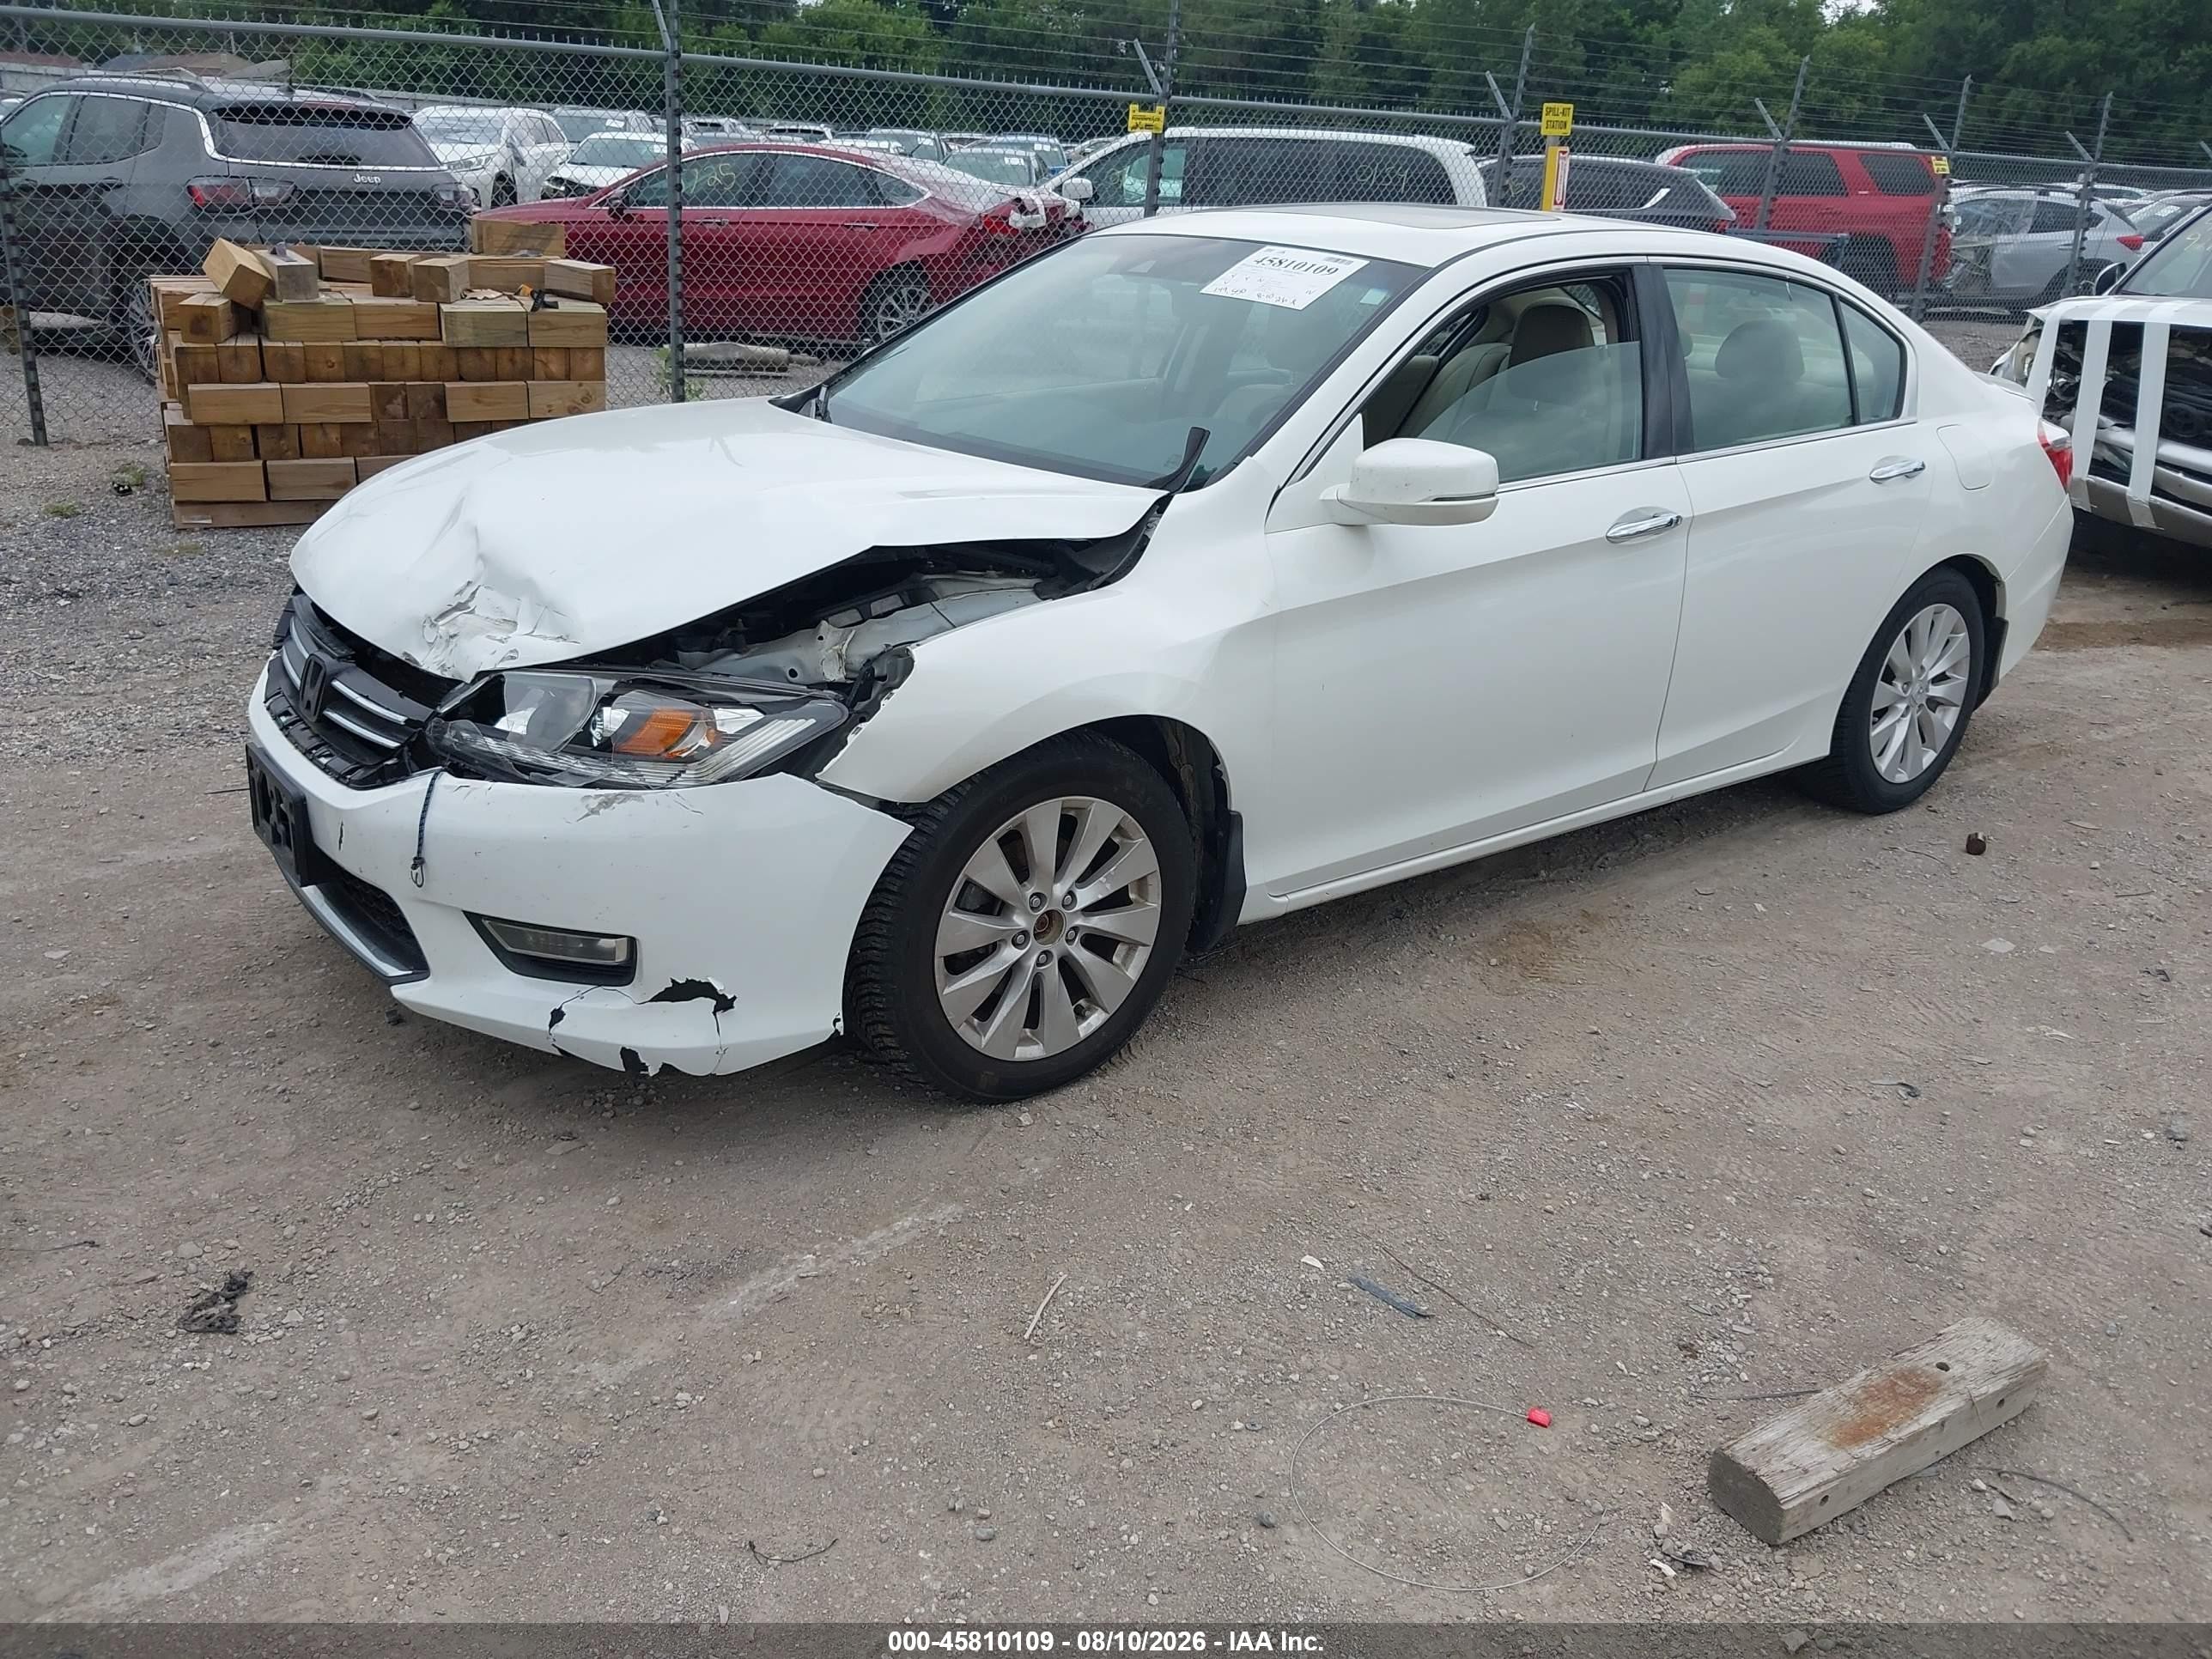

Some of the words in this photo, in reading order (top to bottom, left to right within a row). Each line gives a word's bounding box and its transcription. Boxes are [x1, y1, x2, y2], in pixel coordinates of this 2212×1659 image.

[1545, 106, 1571, 118] SPILL-KIT
[1545, 119, 1568, 130] STATION
[353, 173, 381, 185] Jeep
[1253, 255, 1340, 276] 45810109
